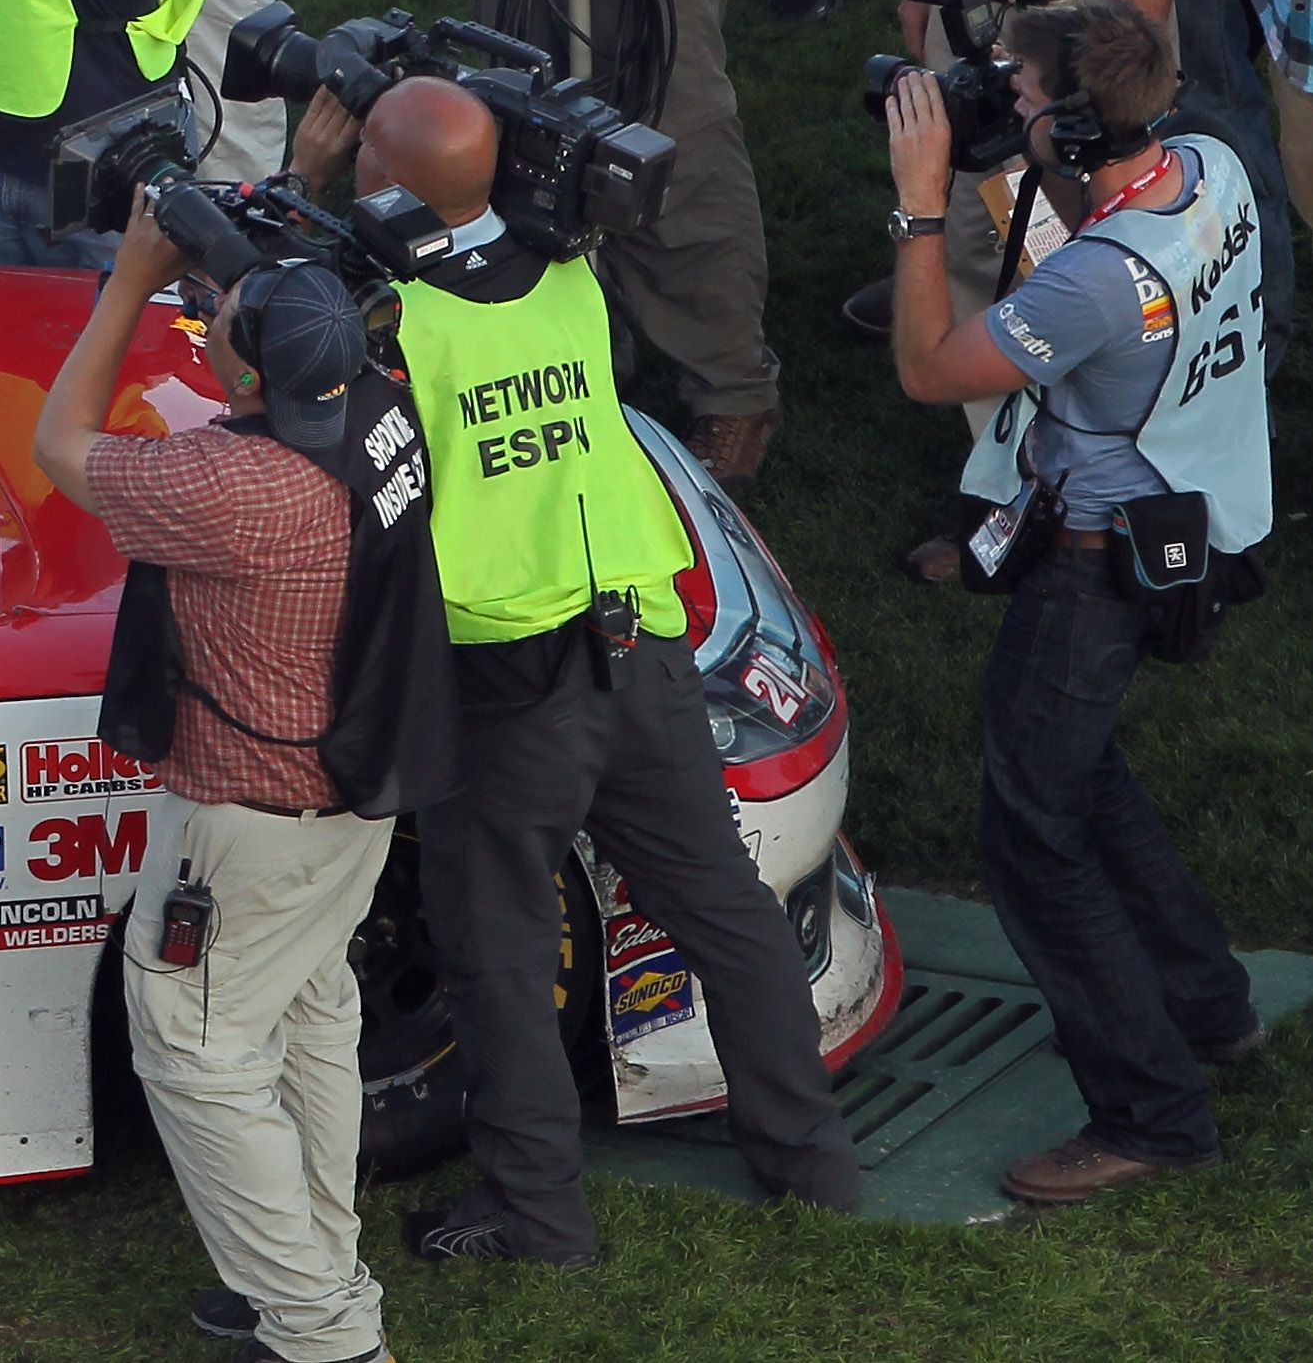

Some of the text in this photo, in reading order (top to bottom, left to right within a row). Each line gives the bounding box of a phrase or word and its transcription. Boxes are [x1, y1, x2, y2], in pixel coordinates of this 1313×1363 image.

[1190, 202, 1257, 316] Kodak
[458, 360, 592, 430] NETWORK
[478, 416, 591, 479] ESPN
[745, 651, 808, 727] 21
[27, 778, 143, 798] HP CARBS
[26, 809, 149, 882] 3M
[3, 923, 110, 948] WELDERS
[615, 970, 689, 1015] SUNOCO
